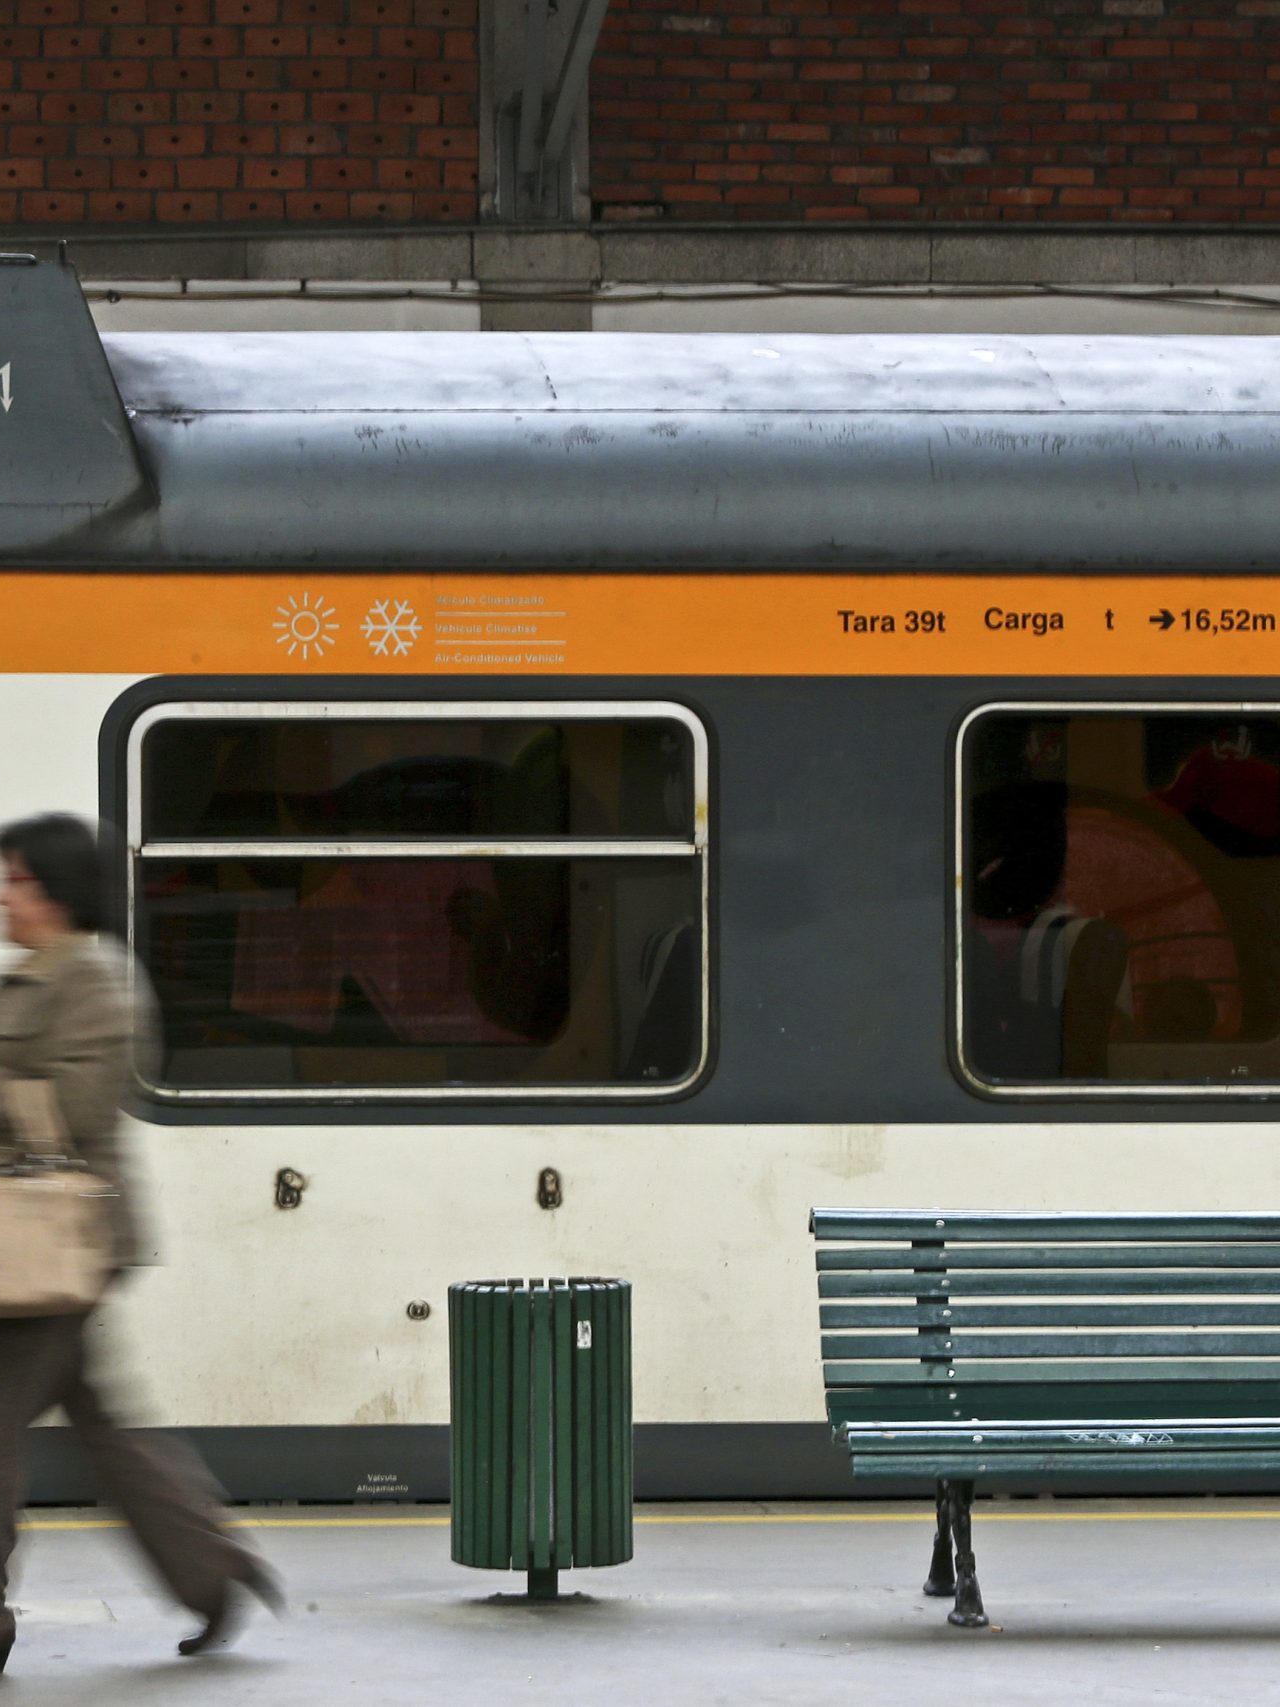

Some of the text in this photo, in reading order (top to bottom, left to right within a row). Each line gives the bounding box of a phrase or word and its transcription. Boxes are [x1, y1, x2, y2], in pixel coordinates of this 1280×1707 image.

[837, 607, 1276, 636] Tara 39t Carga t 16,52m
[435, 652, 565, 664] Air-Conditioned Vehicle
